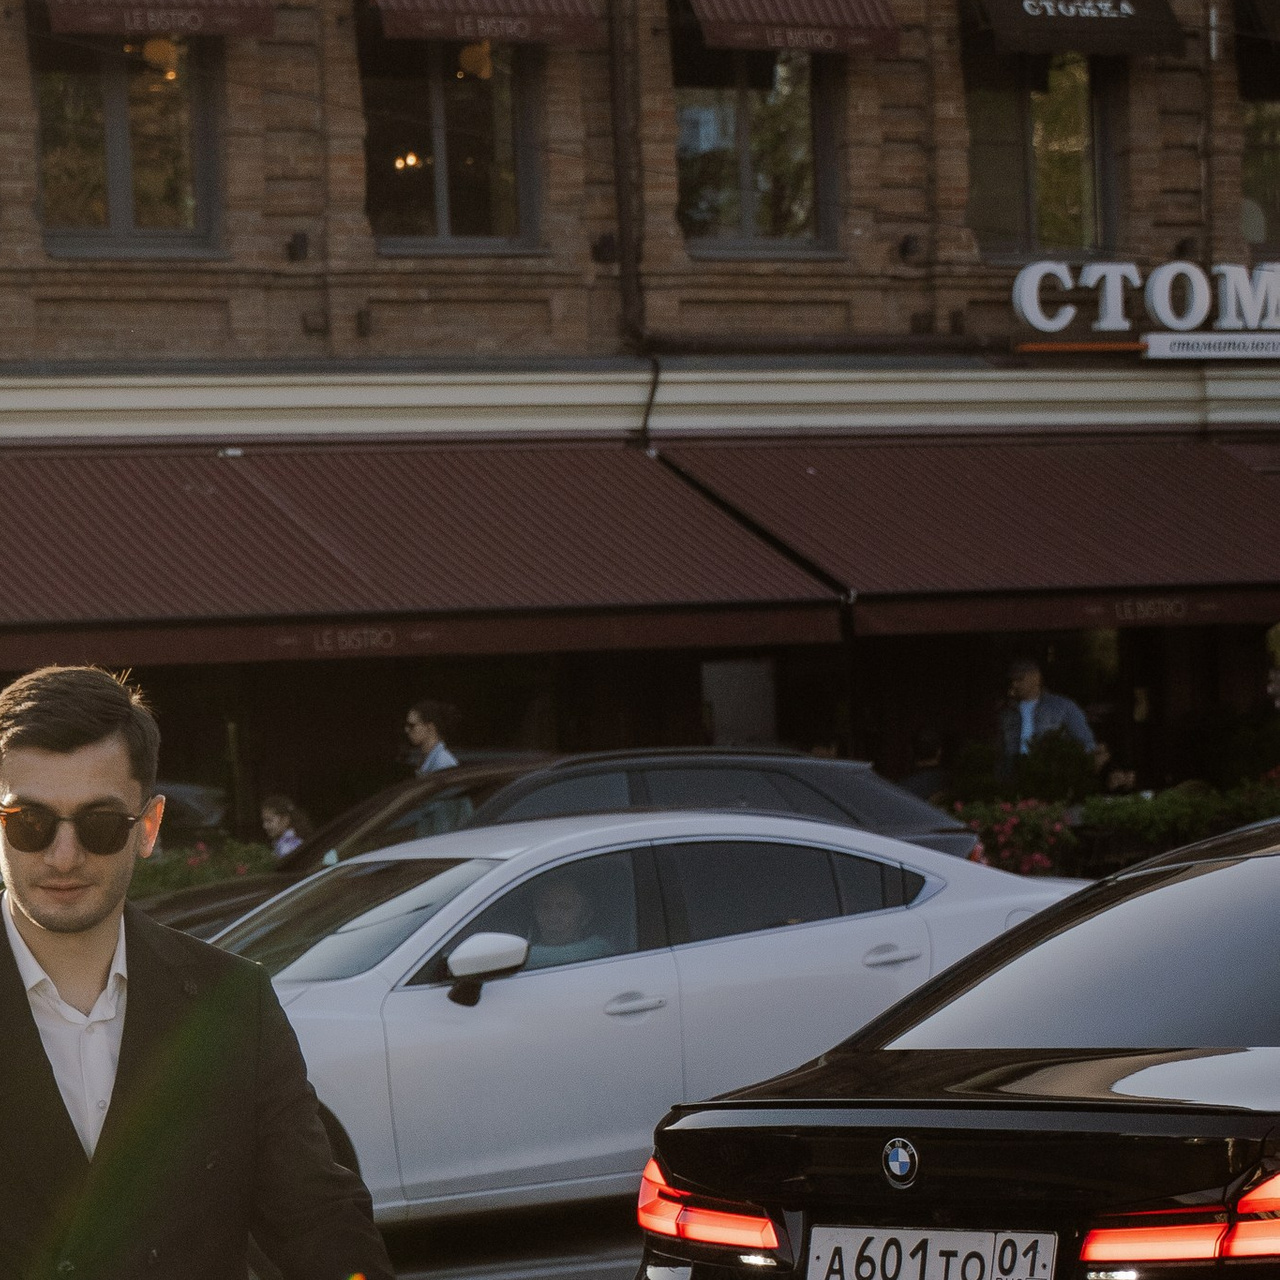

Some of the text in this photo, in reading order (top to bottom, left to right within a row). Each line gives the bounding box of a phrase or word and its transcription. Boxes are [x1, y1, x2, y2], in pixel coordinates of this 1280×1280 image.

[124, 7, 202, 31] LE BISTRO
[455, 16, 530, 39] LE BISTRO
[765, 27, 836, 49] LE BISTRO
[1011, 260, 1280, 333] СТОМ
[1115, 598, 1185, 620] LE BISTRO
[313, 627, 395, 651] LE BISTRO
[996, 1237, 1040, 1278] 01
